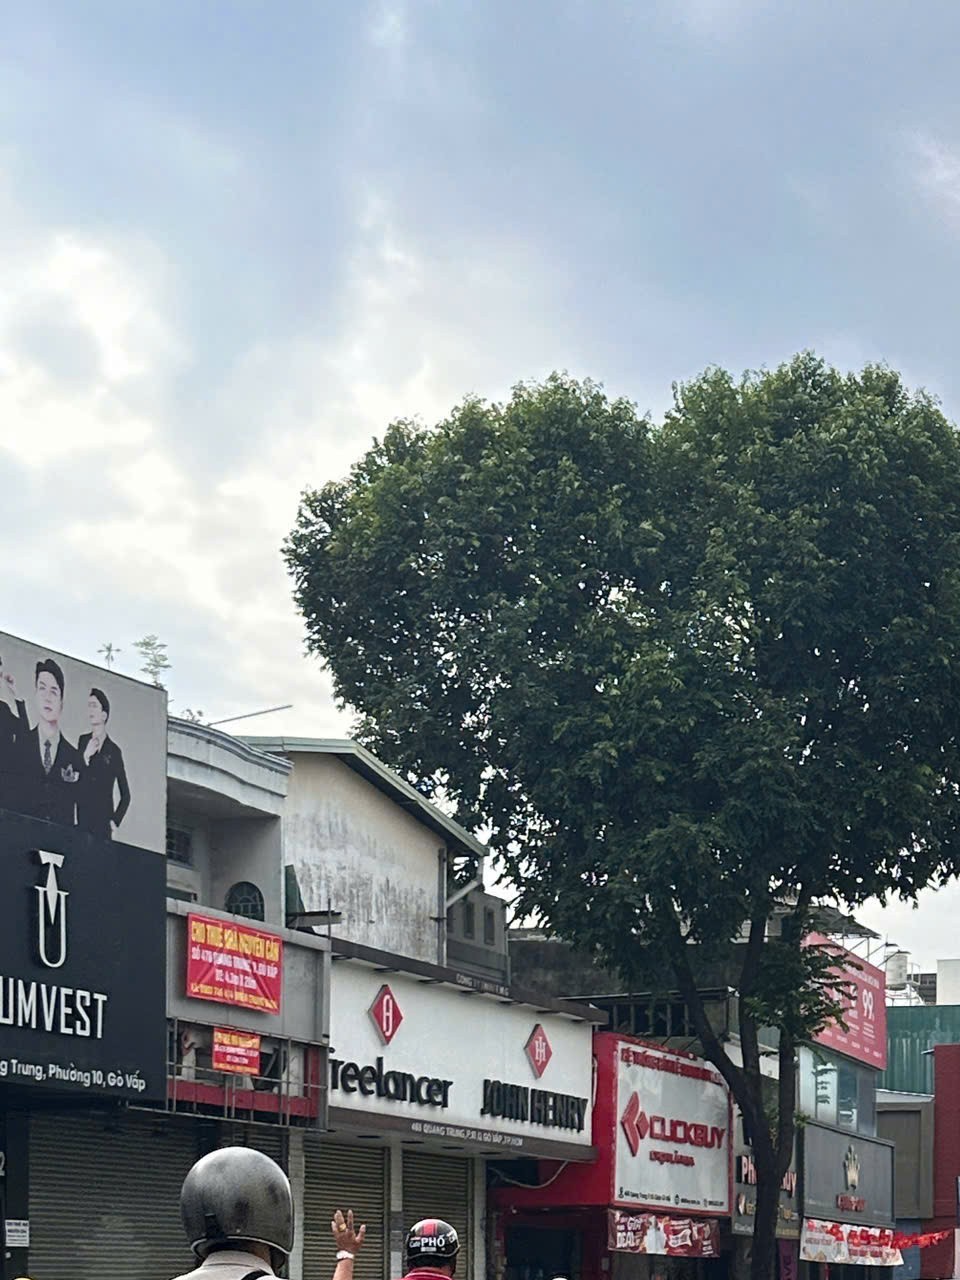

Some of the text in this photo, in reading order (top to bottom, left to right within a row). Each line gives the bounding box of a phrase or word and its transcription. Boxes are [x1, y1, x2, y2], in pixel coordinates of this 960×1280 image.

[0, 976, 108, 1039] UMVEST
[107, 1069, 124, 1087] Gò
[125, 1069, 146, 1092] Vấp
[329, 1047, 453, 1108] reelancer
[480, 1079, 589, 1133] JOHN HENRY
